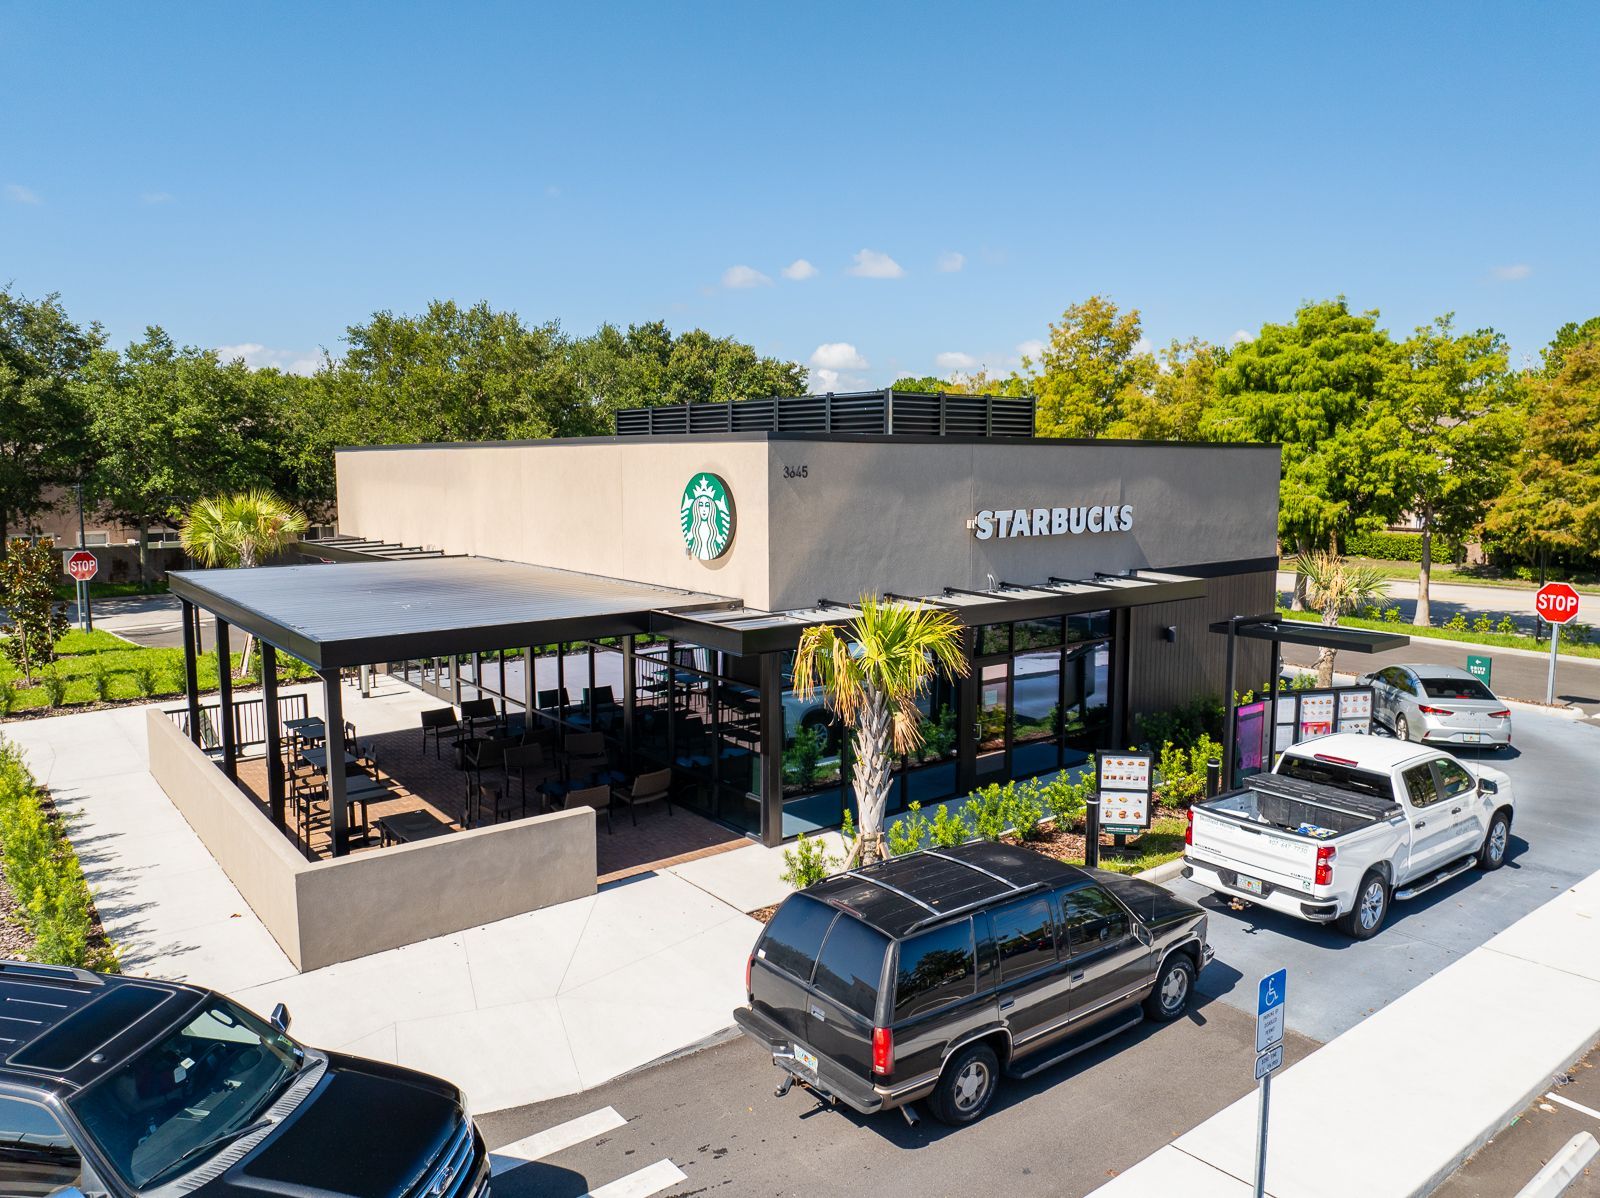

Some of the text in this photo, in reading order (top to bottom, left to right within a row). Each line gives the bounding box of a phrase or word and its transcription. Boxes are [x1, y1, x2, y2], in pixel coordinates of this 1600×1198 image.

[783, 465, 808, 479] 3645
[975, 504, 1133, 540] STARBUCKS
[70, 560, 96, 572] STOP
[1537, 593, 1577, 612] STOP
